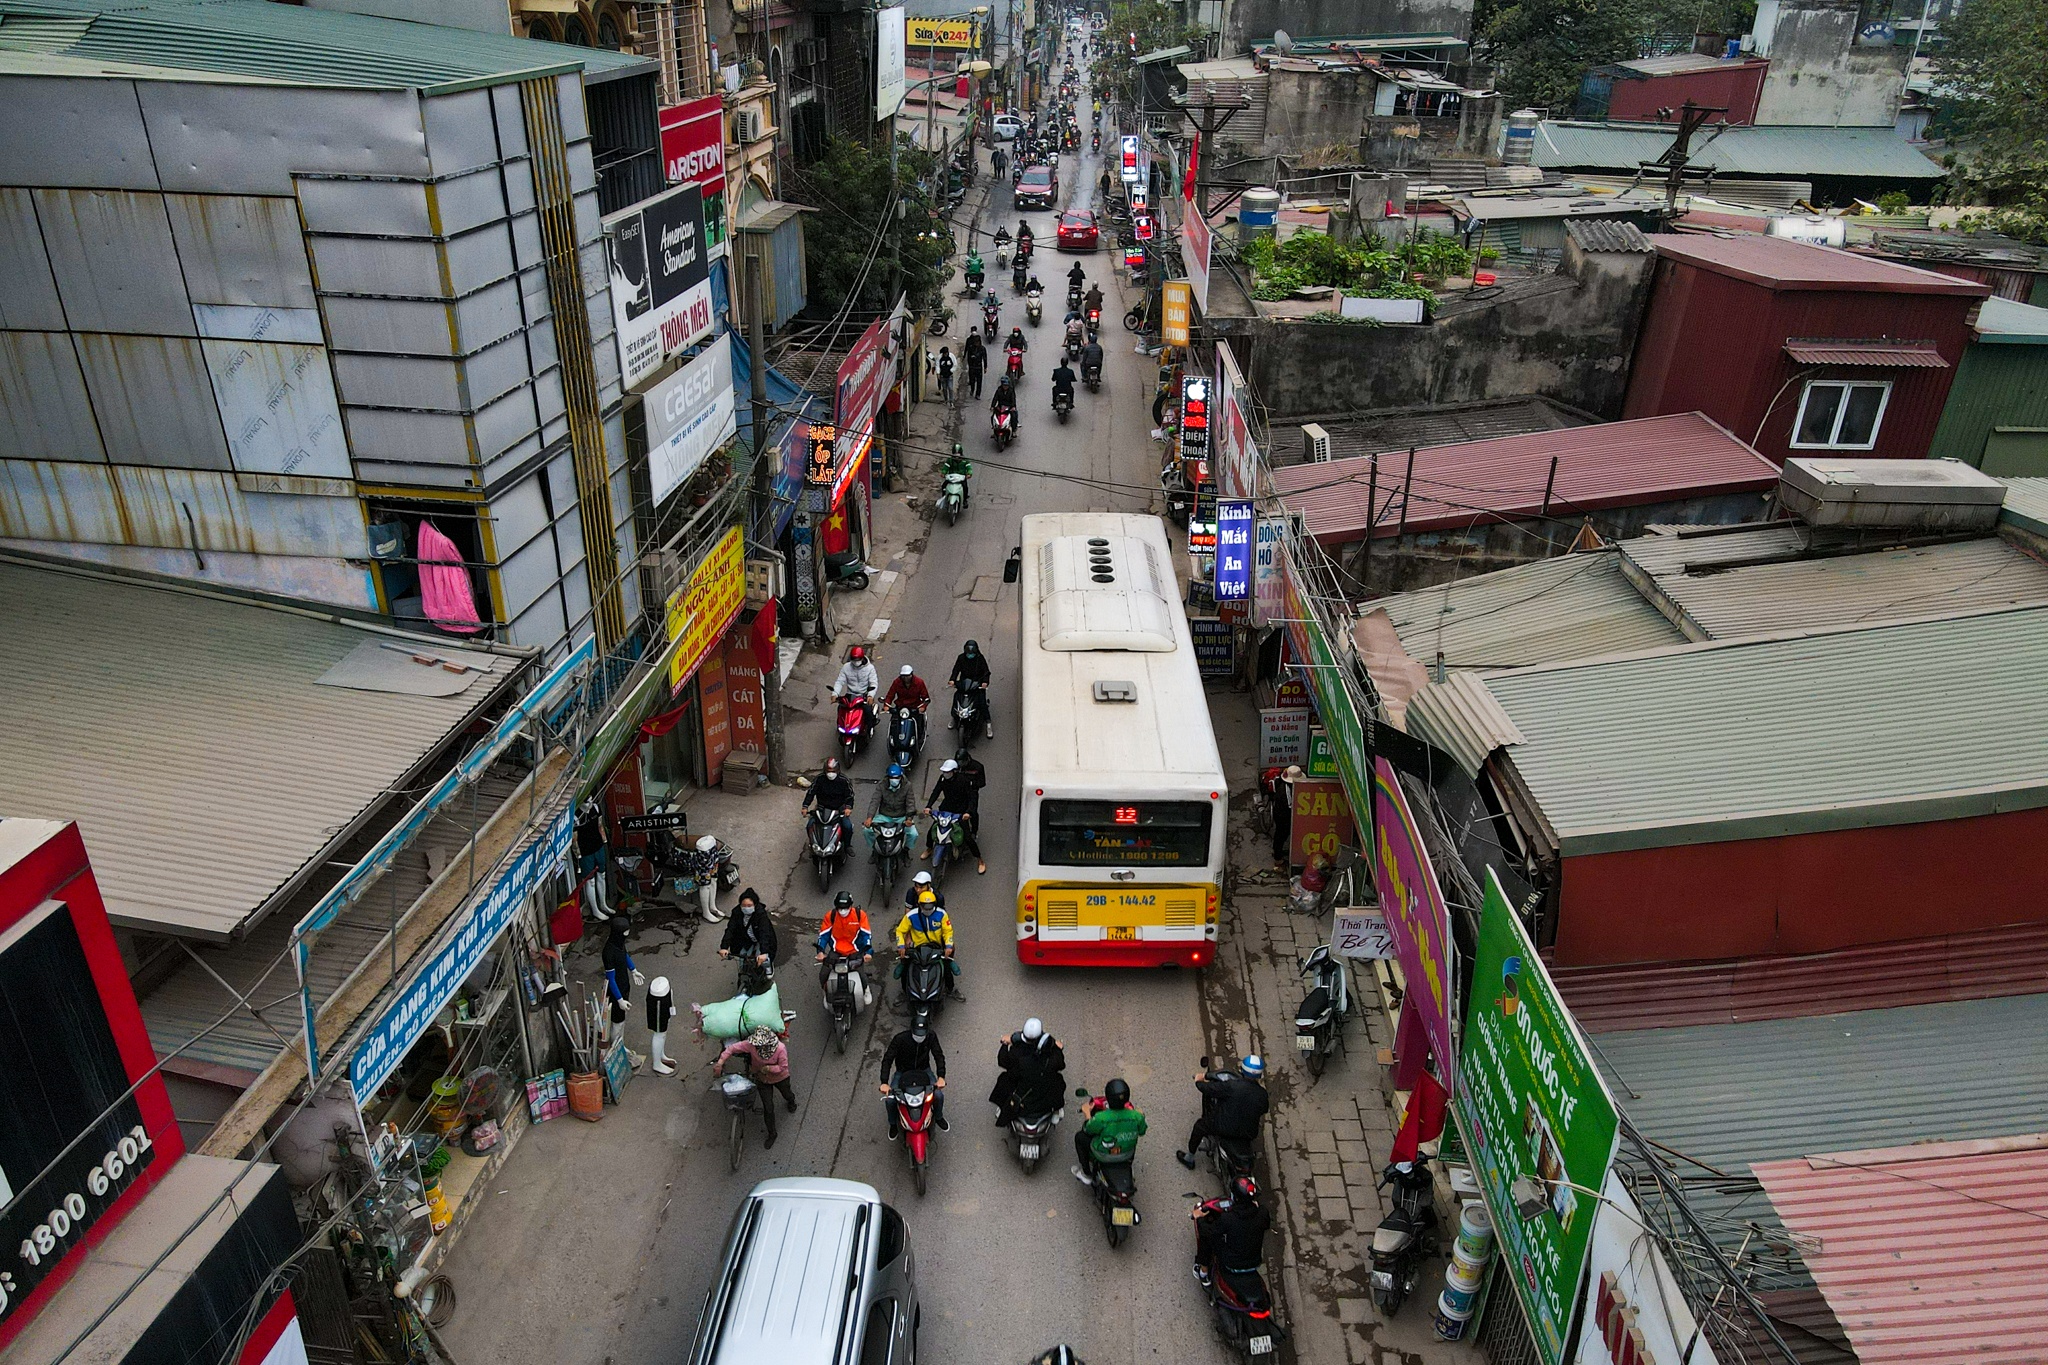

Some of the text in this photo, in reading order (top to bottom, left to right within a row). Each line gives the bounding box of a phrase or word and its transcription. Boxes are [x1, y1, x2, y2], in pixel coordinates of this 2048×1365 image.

[669, 142, 721, 181] ARISTON
[660, 219, 696, 252] American
[663, 244, 696, 277] Standard
[1167, 289, 1186, 303] MUA
[1167, 307, 1185, 322] BÁN
[660, 310, 690, 353] THÔNG
[692, 416, 701, 430] SINH
[701, 409, 710, 422] CAO
[1185, 430, 1205, 443] ĐIỆN
[1219, 504, 1251, 521] Kính
[1221, 527, 1248, 545] Mắt
[1224, 556, 1243, 571] An
[1220, 581, 1246, 599] Việt
[1257, 581, 1283, 600] KÍN
[685, 579, 711, 620] NGỌC
[1195, 622, 1213, 633] KÍNH
[734, 635, 748, 650] XI
[1198, 646, 1227, 655] THAY PIN
[729, 666, 757, 678] MĂNG
[732, 688, 755, 704] CÁT
[1281, 685, 1300, 695] ĐO
[737, 715, 755, 730] ĐÁ
[1296, 786, 1349, 817] SÀN
[628, 817, 680, 828] ARISTINO
[1301, 822, 1340, 858] GỖ
[1078, 851, 1112, 860] Hotline
[1086, 895, 1156, 906] 29B 144.42
[404, 1019, 420, 1042] ĐỒ
[421, 989, 445, 1025] ĐIỆN
[446, 963, 467, 997] DÂN
[468, 928, 494, 967] DỤNG
[556, 830, 569, 854] TAY
[357, 1033, 386, 1081] CỬA
[389, 978, 427, 1035] HÀNG
[429, 947, 455, 991] KIM
[457, 916, 479, 955] KHÍ
[480, 882, 510, 932] TỔNG
[511, 858, 532, 893] HỢP
[1551, 1003, 1565, 1028] GOLD
[1563, 1024, 1575, 1048] VIỆT
[1573, 1045, 1585, 1071] NAM
[1477, 1011, 1518, 1116] CƯỜNG TRANG
[1531, 1030, 1578, 1132] QUỐC TẾ
[1472, 1047, 1493, 1107] NHẬN
[1492, 1099, 1505, 1132] TƯ
[1504, 1125, 1521, 1176] VẤN
[19, 1125, 152, 1266] 1800 6601
[1464, 1052, 1475, 1089] THI
[1474, 1085, 1495, 1142] CÔNG
[1494, 1139, 1511, 1185] SƠN
[1522, 1220, 1546, 1279] RỌN
[1545, 1274, 1563, 1325] GÓI
